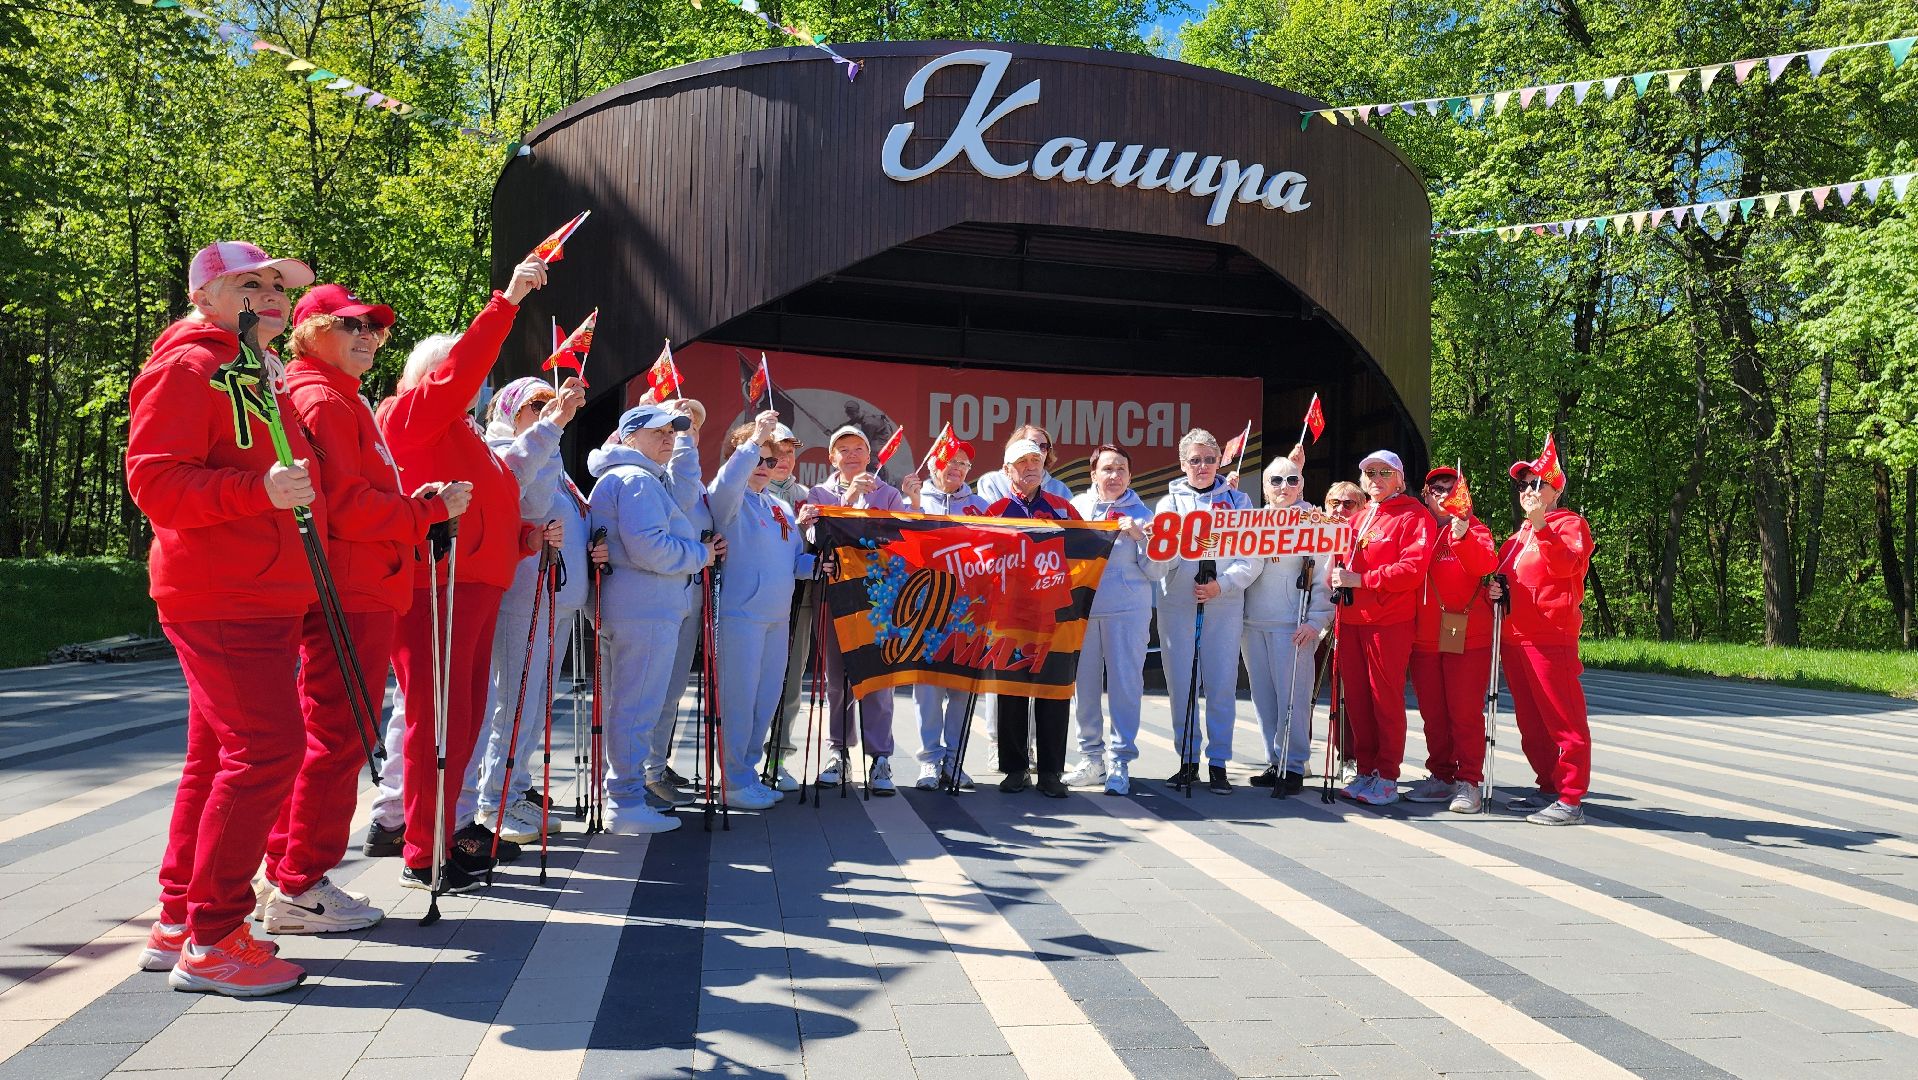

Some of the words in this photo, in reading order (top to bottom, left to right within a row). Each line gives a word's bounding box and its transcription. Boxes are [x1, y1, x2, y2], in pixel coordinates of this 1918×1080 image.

[881, 49, 1311, 226] Кашира
[929, 392, 1191, 446] ГОРДИМСЯ!
[799, 462, 835, 485] МА
[1147, 510, 1212, 560] 80
[1214, 507, 1300, 528] ВЕЛИКОЙ
[1218, 528, 1351, 557] ПОБЕДЫ!
[932, 539, 1027, 594] Победа!
[1034, 550, 1060, 575] 80
[881, 568, 956, 665] 9
[932, 632, 1052, 673] МАЯ
